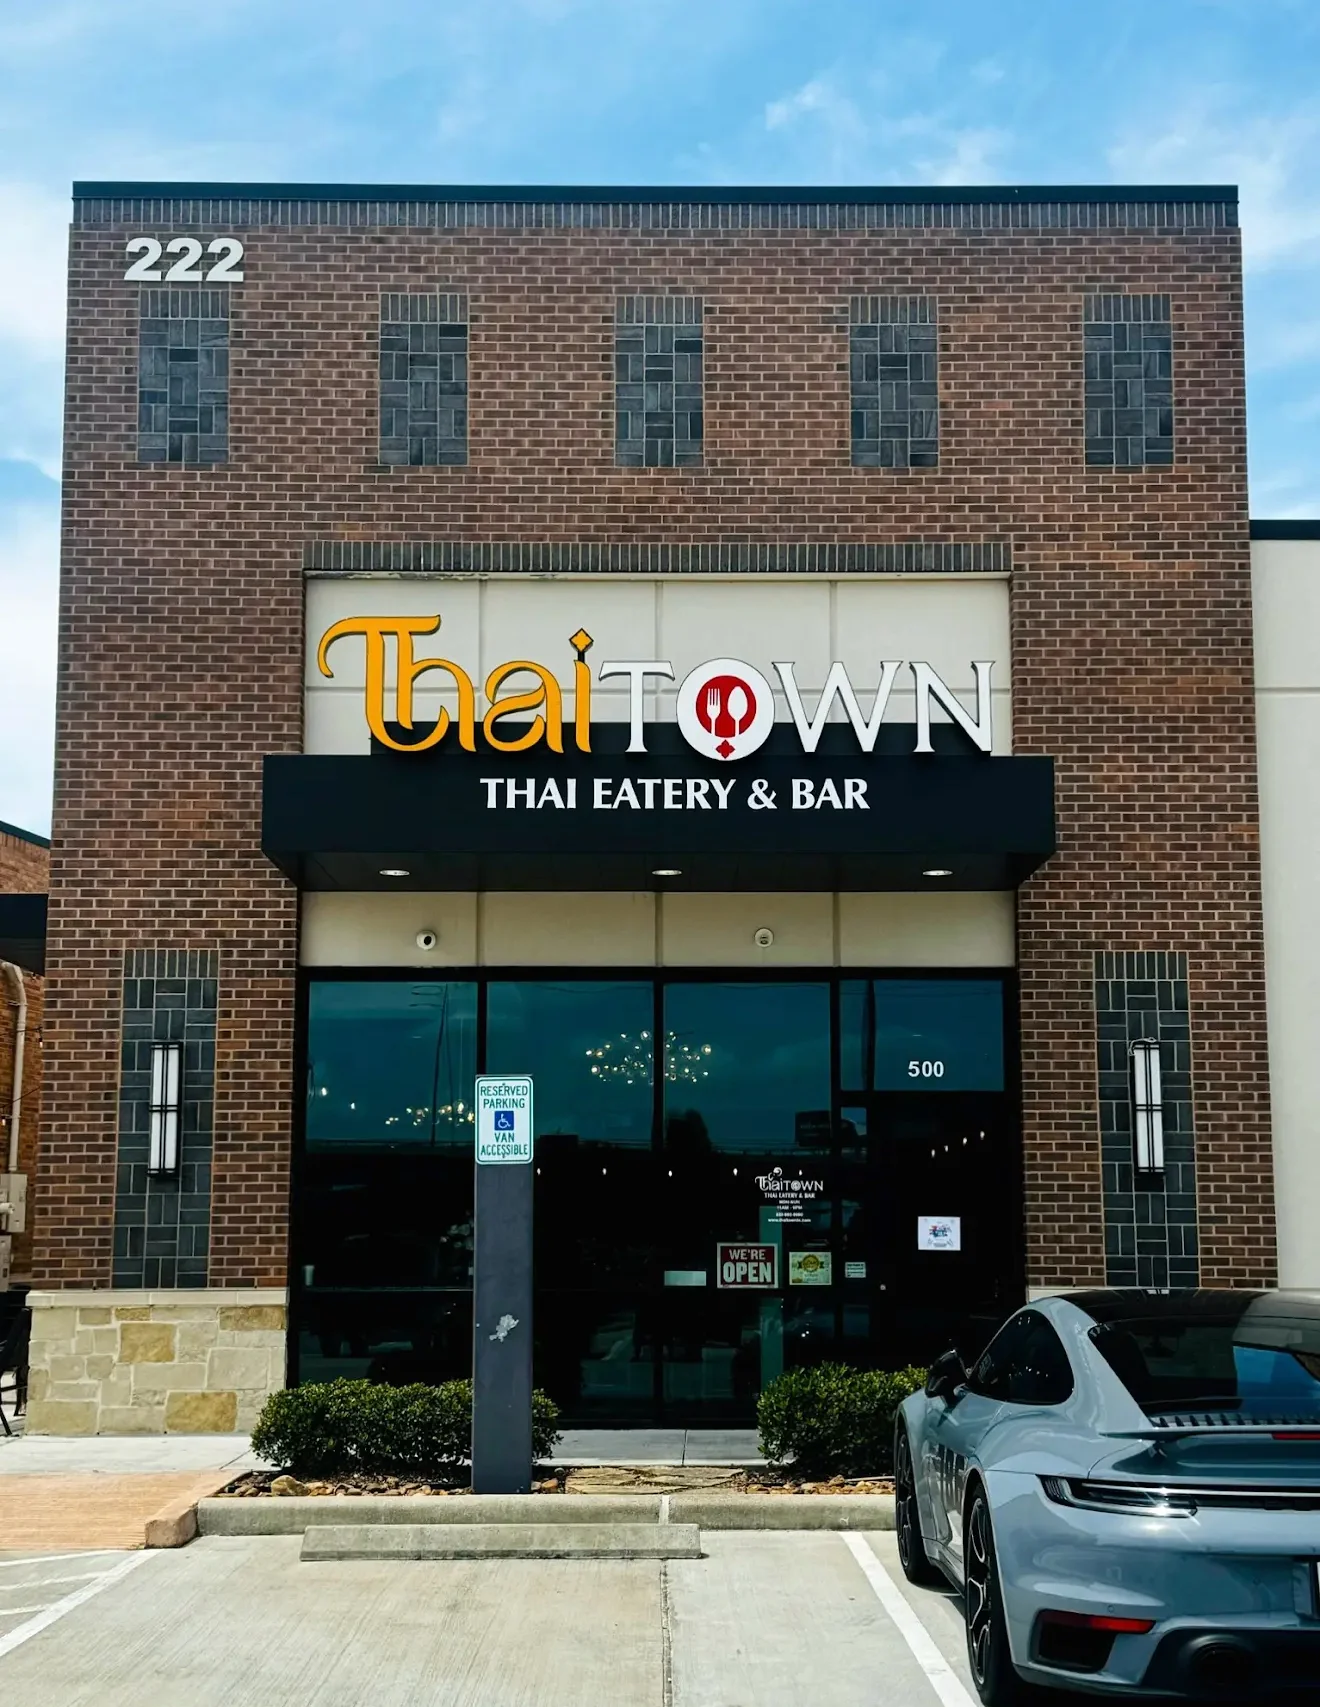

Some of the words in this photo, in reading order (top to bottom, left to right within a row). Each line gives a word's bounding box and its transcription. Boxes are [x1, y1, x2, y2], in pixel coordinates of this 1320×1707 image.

[124, 237, 244, 282] 222
[480, 778, 577, 809] THAI
[593, 778, 736, 810] EATERY
[747, 779, 778, 810] &
[791, 778, 871, 810] BAR
[908, 1060, 944, 1078] 500
[480, 1085, 528, 1096] RESERVED
[483, 1098, 525, 1108] PARKING
[494, 1132, 515, 1143] VAN
[480, 1144, 528, 1156] ACCESSIBLE
[729, 1248, 767, 1260] WE'RE
[723, 1261, 772, 1283] OPEN
